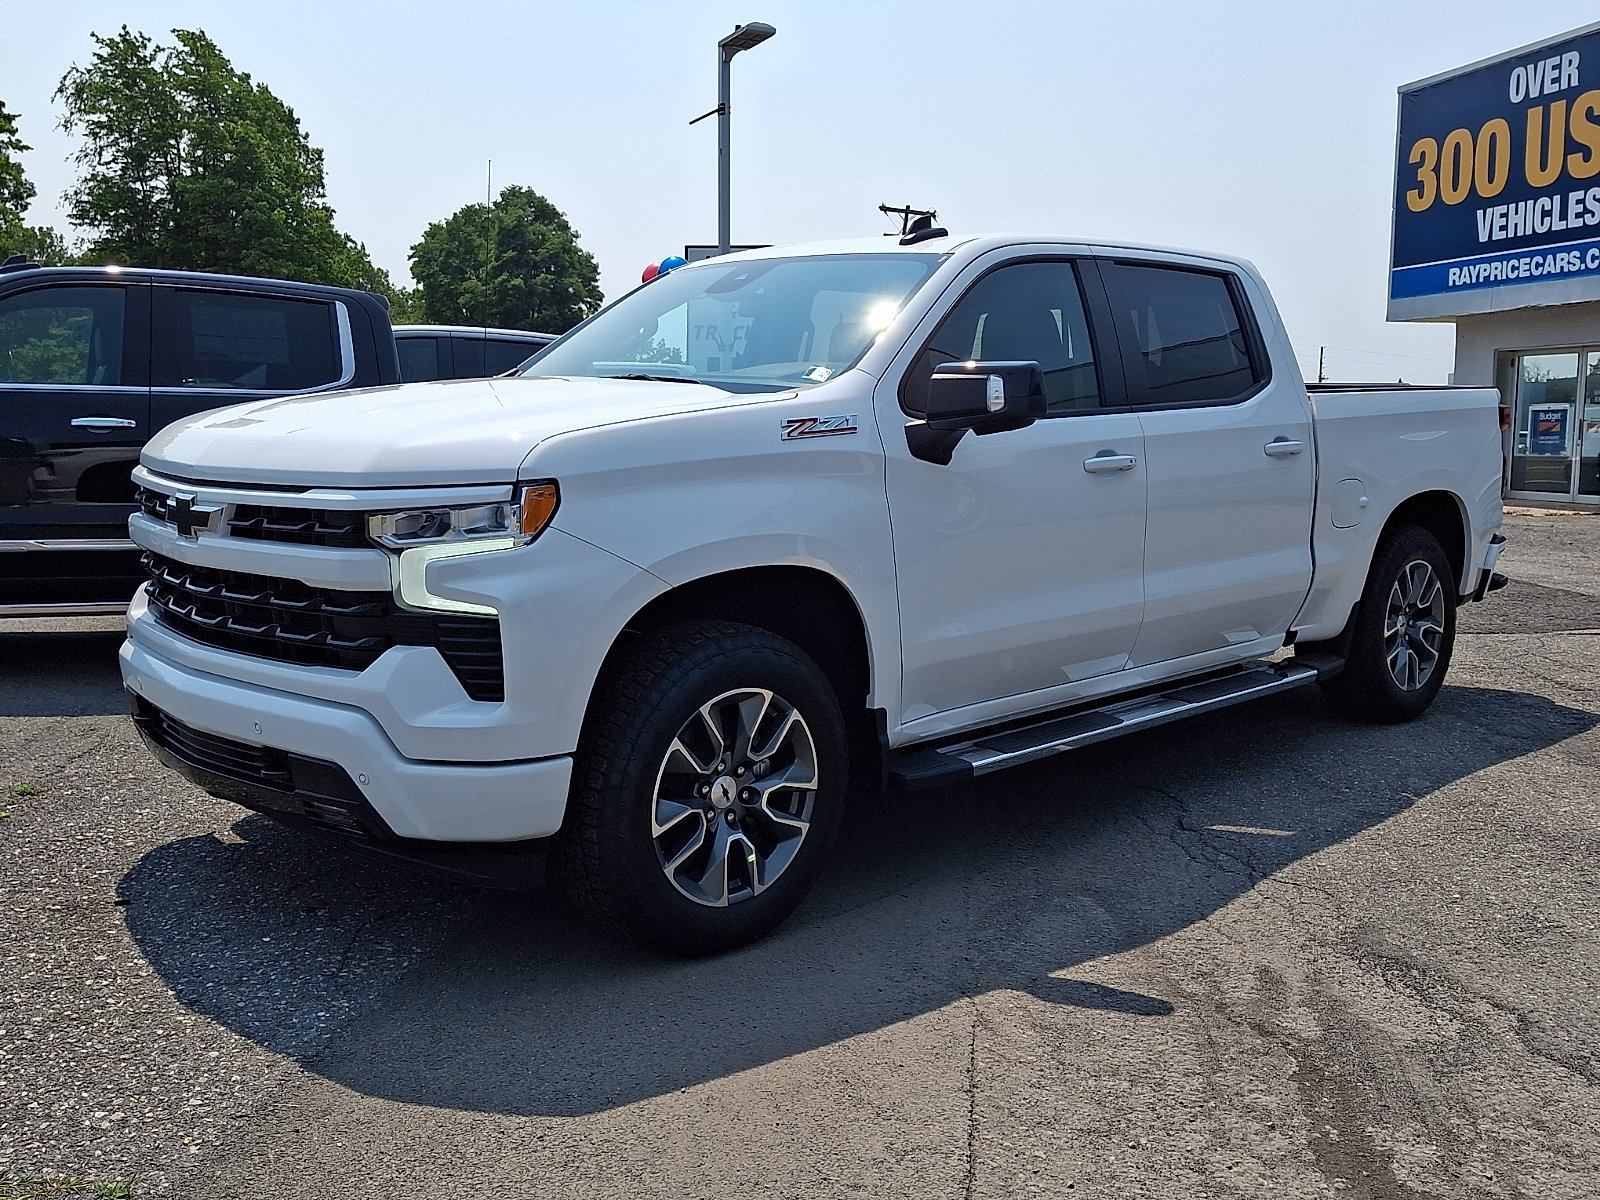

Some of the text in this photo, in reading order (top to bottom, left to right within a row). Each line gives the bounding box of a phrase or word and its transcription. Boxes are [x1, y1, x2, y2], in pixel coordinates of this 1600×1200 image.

[1509, 50, 1581, 104] OVER
[1406, 117, 1511, 212] 300
[1476, 186, 1600, 243] VEHICLES
[781, 413, 858, 441] Z71
[1539, 412, 1562, 422] Budget
